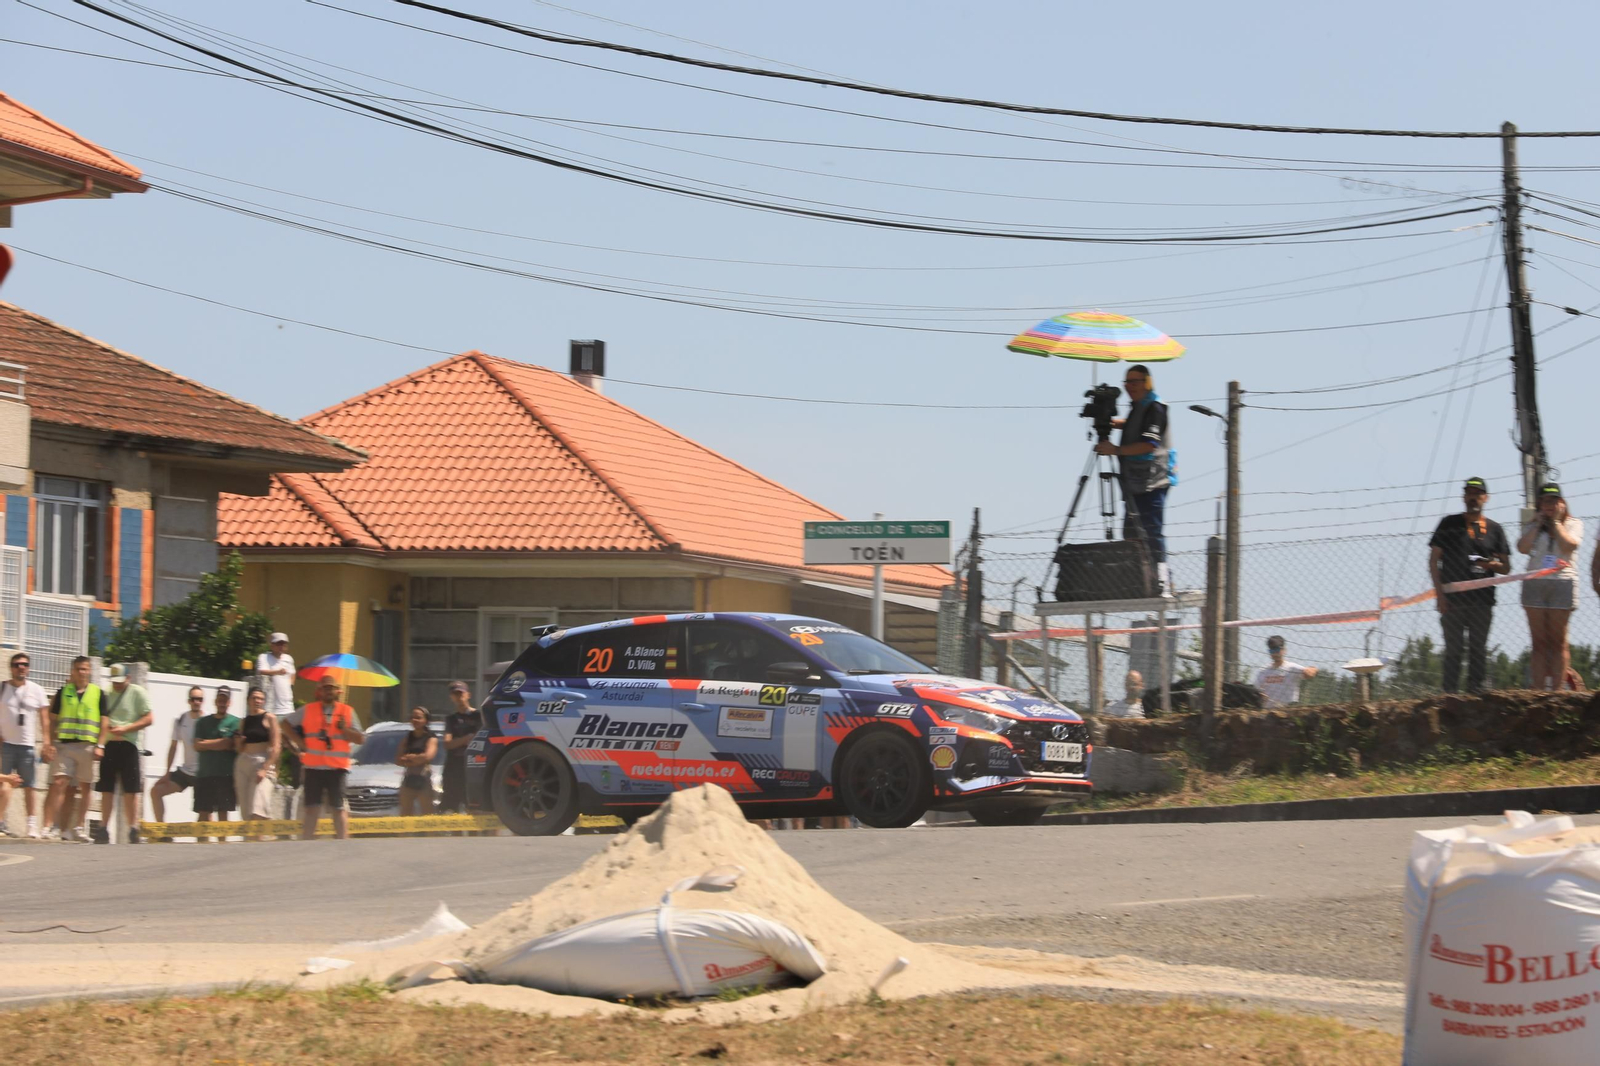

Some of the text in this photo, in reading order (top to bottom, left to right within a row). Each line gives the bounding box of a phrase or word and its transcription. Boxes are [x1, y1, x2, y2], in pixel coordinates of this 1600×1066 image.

[816, 525, 884, 535] CONCELLO
[887, 524, 906, 535] DE
[849, 541, 905, 561] TOÉN
[624, 646, 665, 657] A.Blanco
[583, 647, 614, 673] 20
[627, 660, 656, 670] D.Villa
[601, 691, 645, 701] Asturdai
[700, 685, 715, 695] La
[760, 686, 787, 704] 20
[536, 700, 566, 713] GT2i
[877, 703, 917, 716] GT2i
[575, 713, 688, 738] Blanco
[570, 738, 655, 750] MOTOR
[631, 763, 736, 778] ruedausada.es
